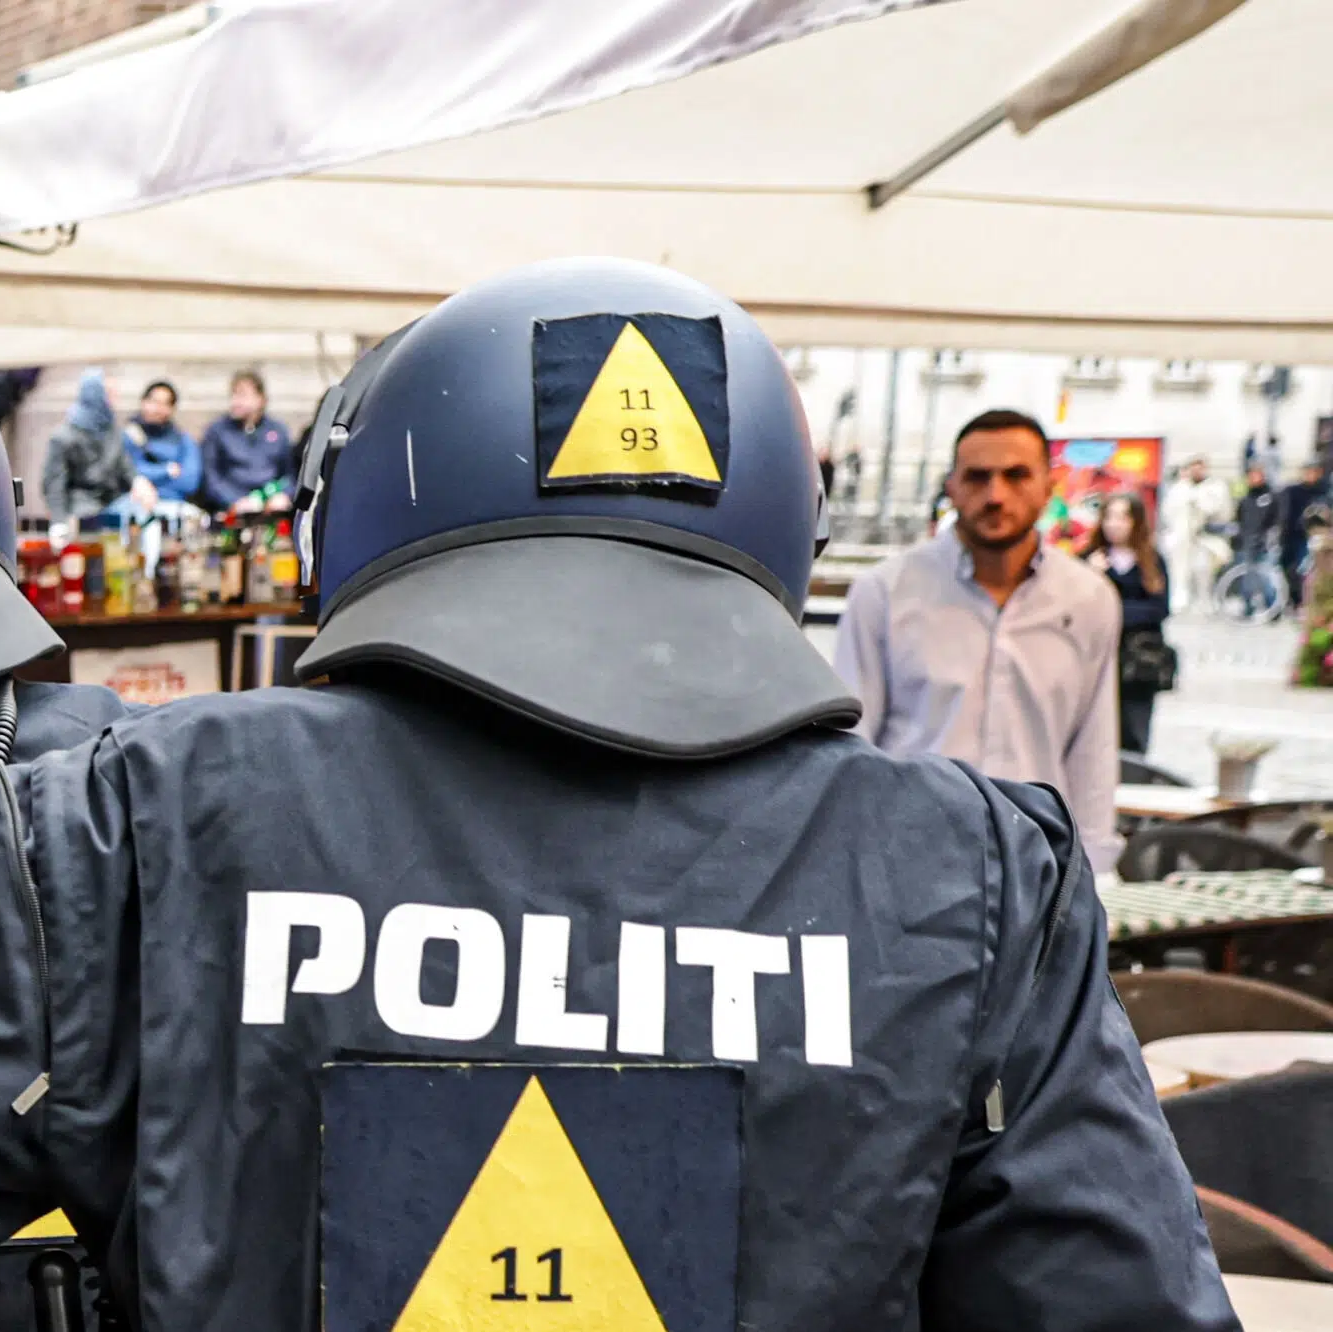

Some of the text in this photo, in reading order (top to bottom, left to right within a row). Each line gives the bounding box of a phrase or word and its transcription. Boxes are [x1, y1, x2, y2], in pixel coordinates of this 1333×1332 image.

[618, 388, 656, 411] 11
[620, 426, 659, 451] 93
[241, 891, 853, 1068] POLITI
[489, 1246, 574, 1303] 11
